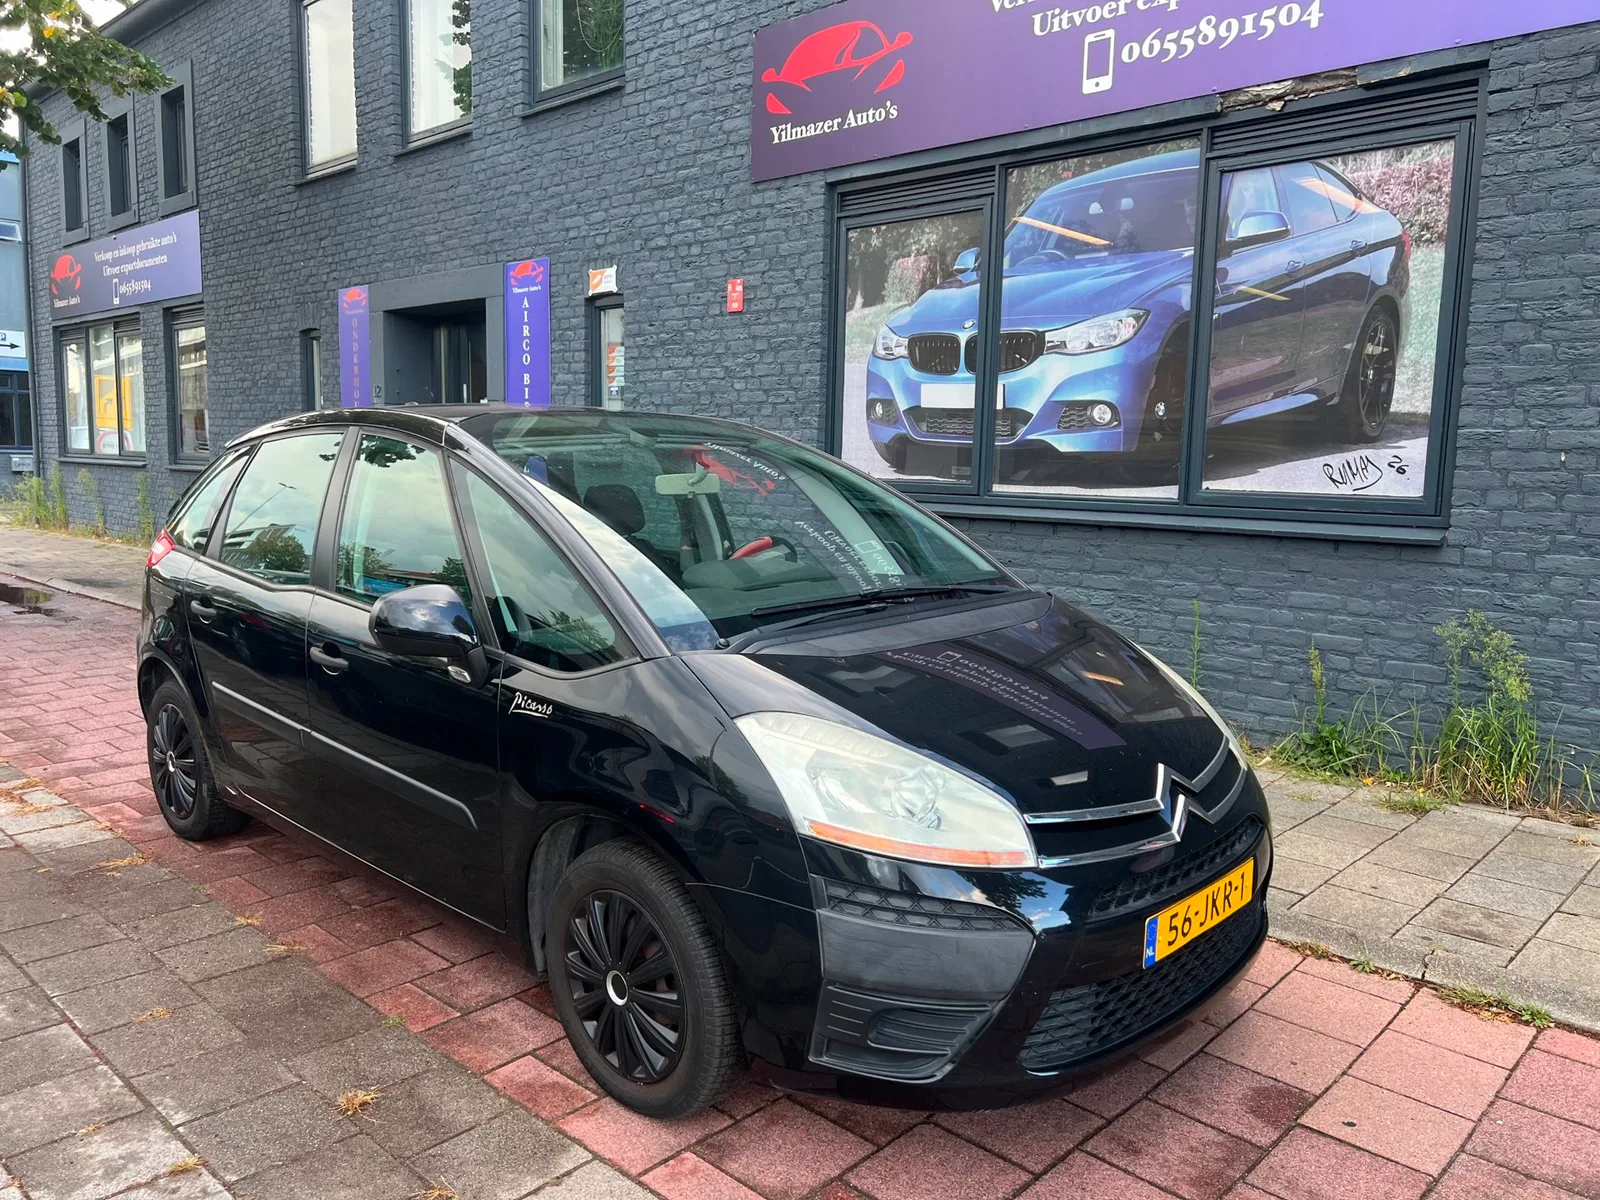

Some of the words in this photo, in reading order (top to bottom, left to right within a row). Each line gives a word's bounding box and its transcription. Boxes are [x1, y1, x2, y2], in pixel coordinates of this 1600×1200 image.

[1032, 0, 1132, 36] Uitvoer
[1121, 0, 1325, 63] 0655891504
[770, 117, 842, 144] Yilmazer
[843, 100, 899, 129] Auto's
[94, 250, 113, 263] Verkoop
[113, 248, 119, 259] en
[119, 244, 136, 257] inkoop
[136, 237, 161, 256] gebruikte
[103, 265, 120, 277] Uitvoer
[120, 254, 168, 275] exportdocumenten
[119, 279, 152, 296] 0655891504
[522, 296, 531, 366] AIRCO
[508, 691, 553, 717] Picasso
[1145, 946, 1155, 958] NL
[1168, 871, 1245, 947] 56-JKR-1
